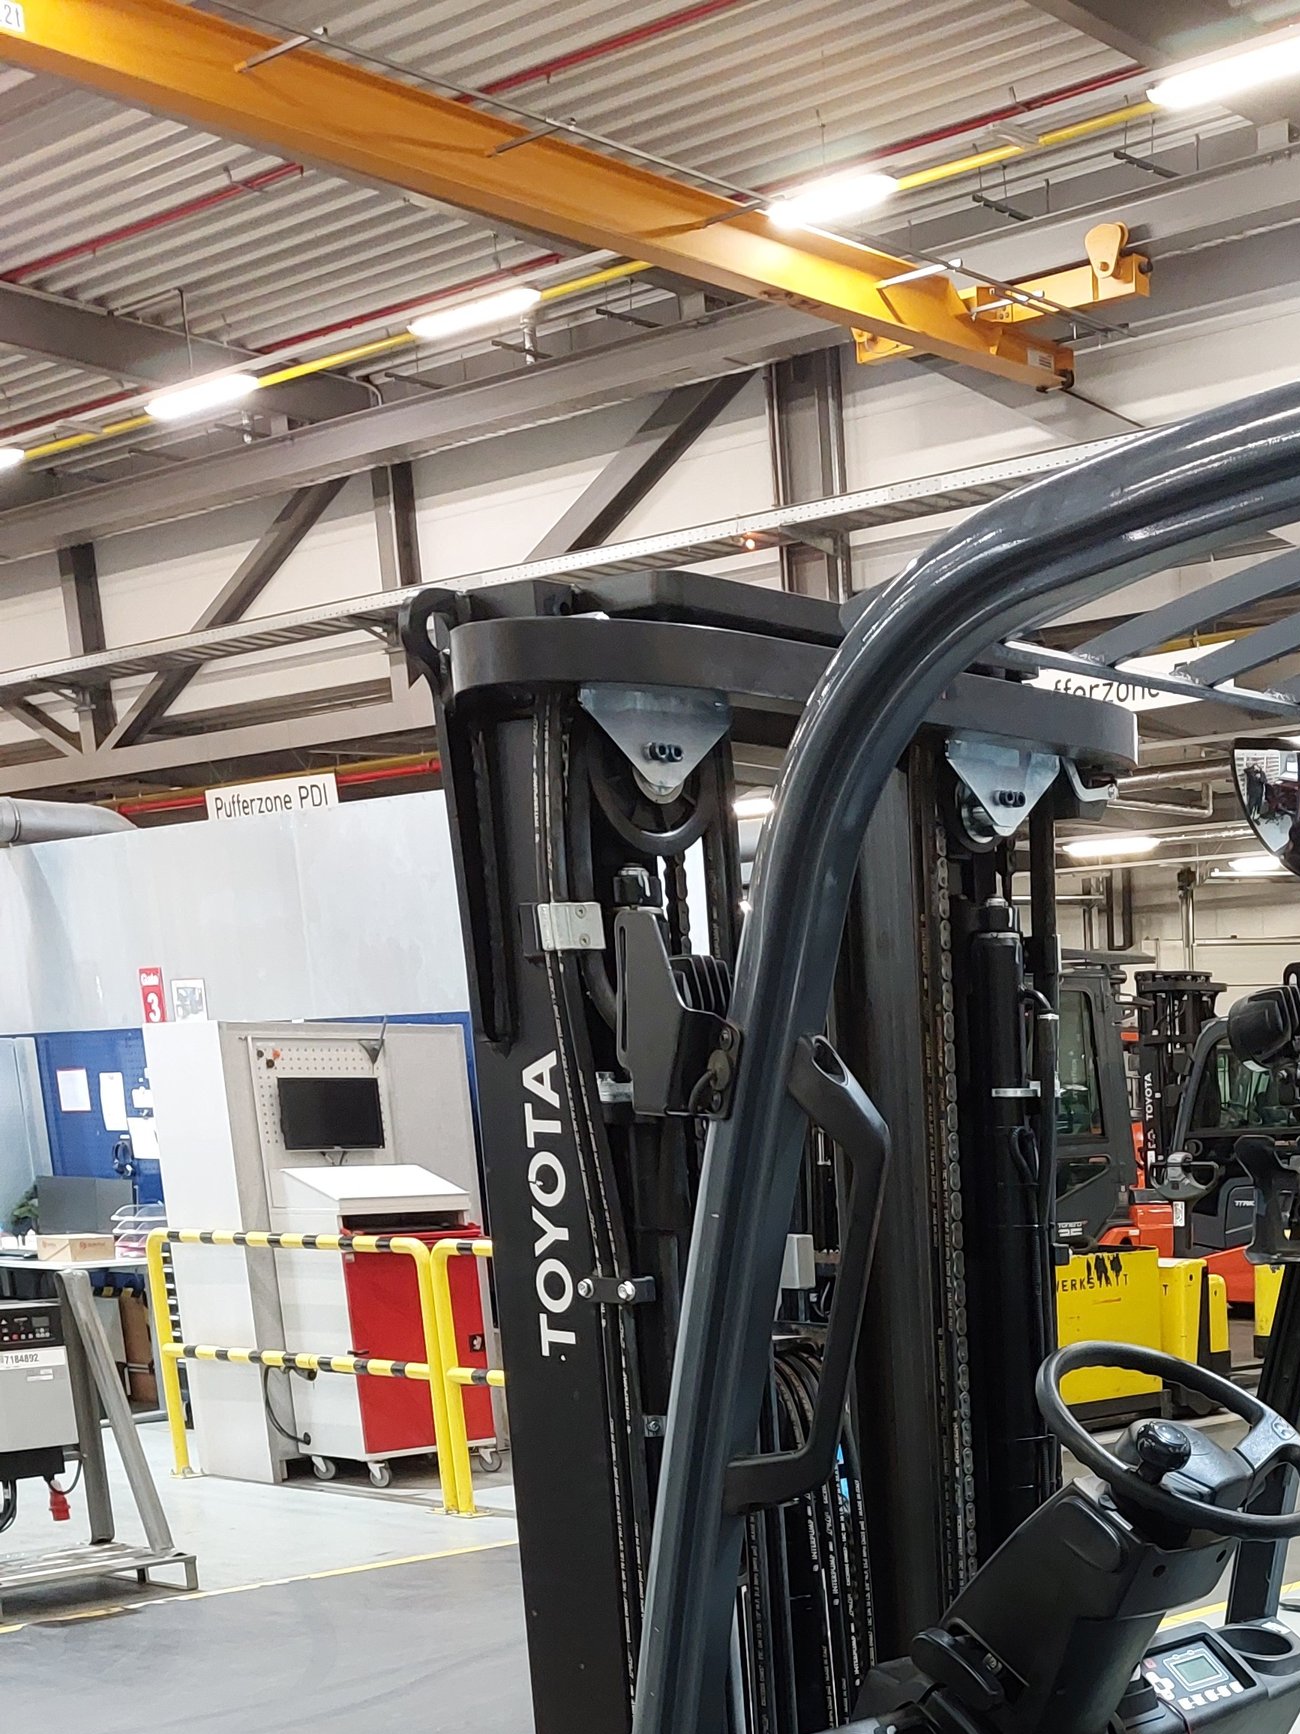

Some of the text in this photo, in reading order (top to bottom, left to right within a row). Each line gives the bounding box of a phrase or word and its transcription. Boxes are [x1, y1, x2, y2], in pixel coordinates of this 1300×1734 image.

[214, 782, 328, 819] Pufferzone PDI
[147, 992, 161, 1022] 3
[1144, 1072, 1154, 1121] TOYOTA
[522, 1050, 576, 1356] TOYOTA
